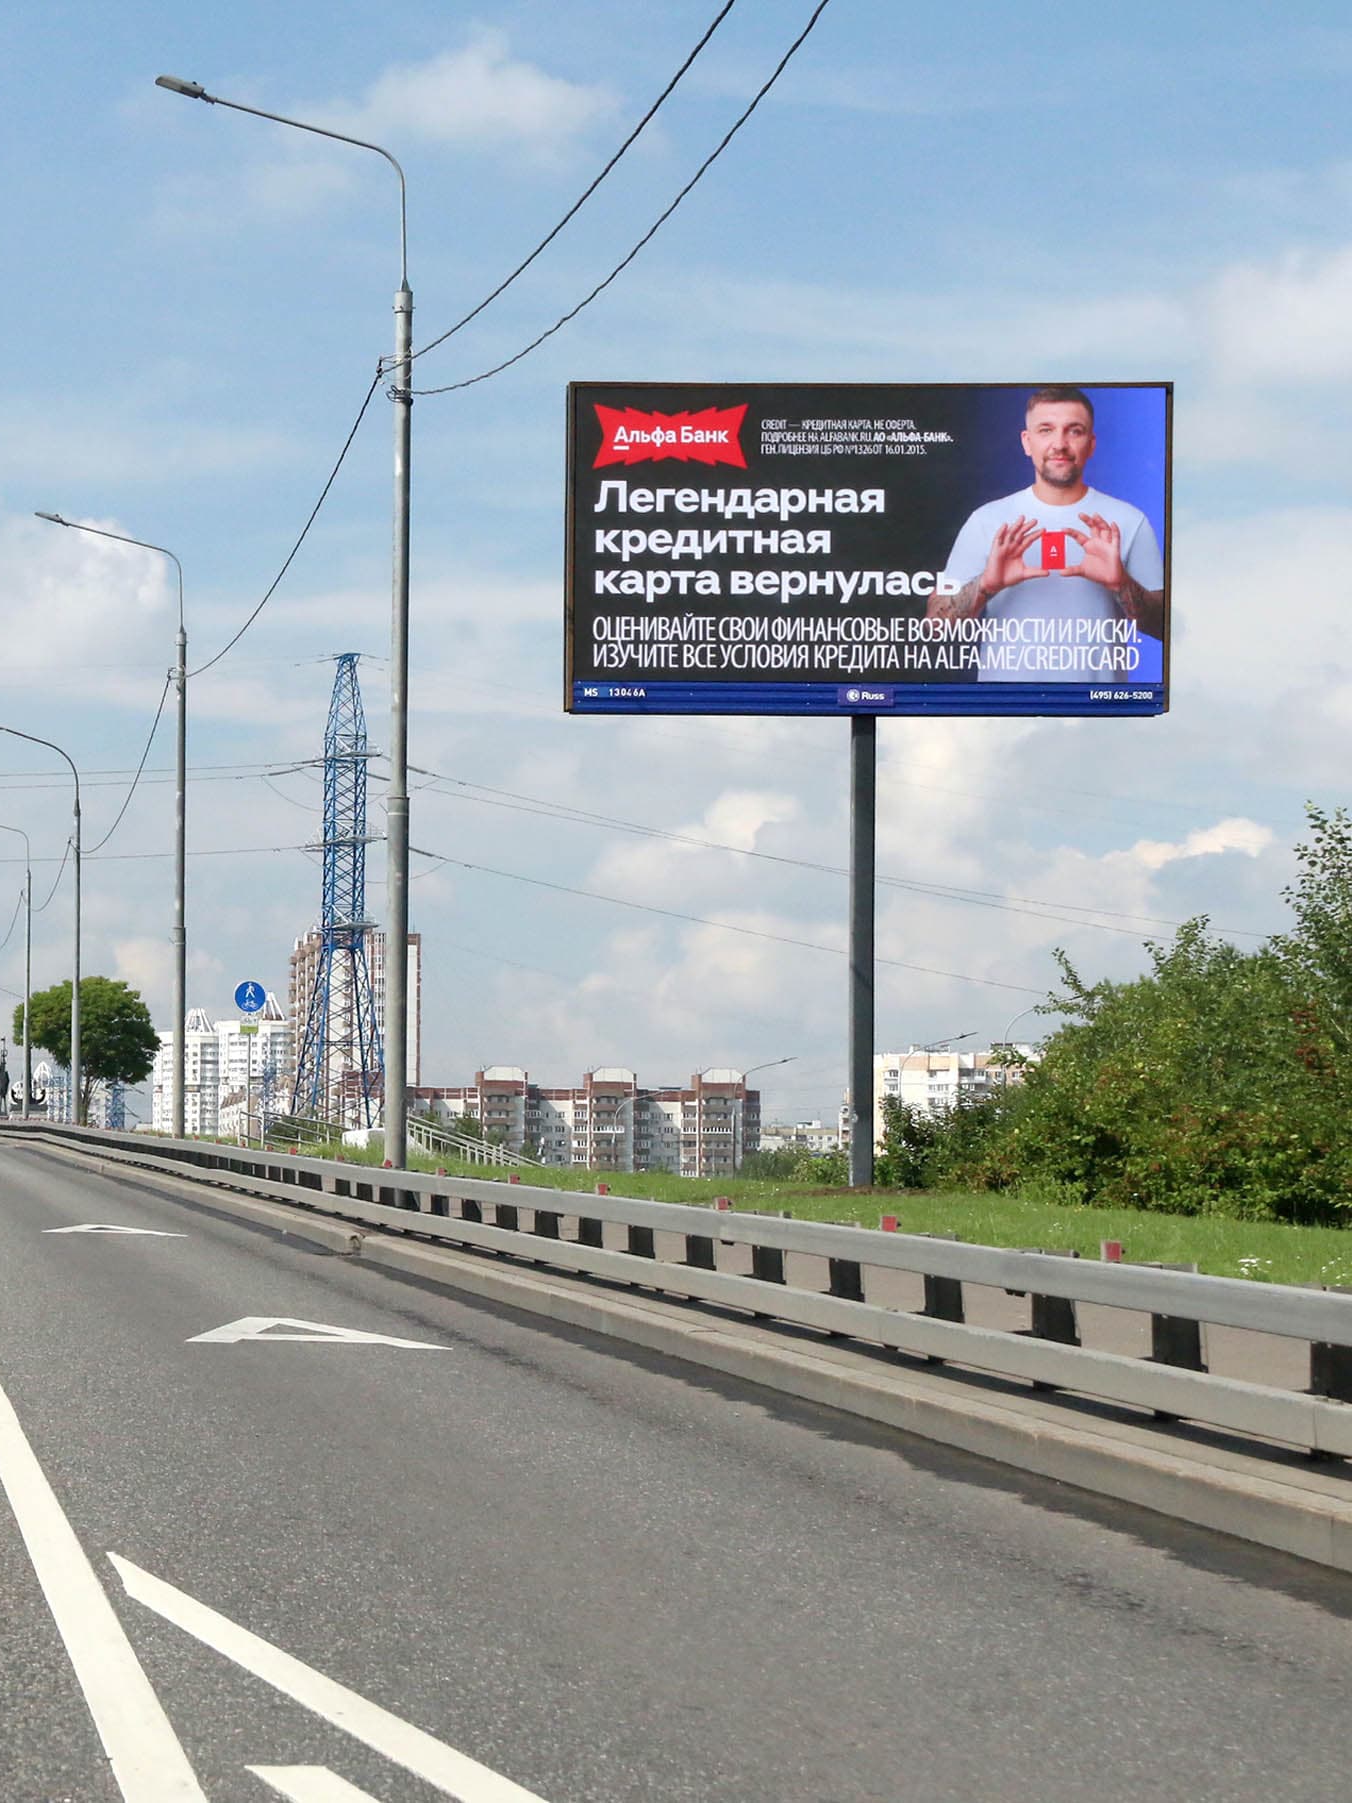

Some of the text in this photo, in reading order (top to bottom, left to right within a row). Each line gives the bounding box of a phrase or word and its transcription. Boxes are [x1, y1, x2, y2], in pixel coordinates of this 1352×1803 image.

[761, 419, 787, 430] CREDIT
[801, 419, 847, 432] КРЕДИТНАЯ
[874, 419, 884, 430] НЕ
[612, 426, 729, 450] Альфа Банк
[761, 431, 807, 444] ПОДРОБНЕЕ
[807, 432, 820, 442] НА
[873, 432, 886, 442] АО
[777, 444, 820, 456] ЛИЦЕНЗИЯ
[873, 445, 883, 455] ОТ
[594, 480, 886, 521] Легендарная
[595, 529, 831, 562] кредитная
[595, 570, 961, 604] карта вернулась
[592, 613, 1142, 645] ОЦЕНИВАЙТЕ СВОИ ФИНАНСОВЫЕ ВОЗМОЖНОСТИ И РИСКИ.
[593, 644, 1140, 673] ИЗУЧИТЕ ВСЕ УСЛОВИЯ КРЕДИТА НА ALFA.ME/CREDITCARD
[584, 688, 599, 697] MS
[861, 691, 886, 700] Russ
[1113, 690, 1153, 700] 626-5200
